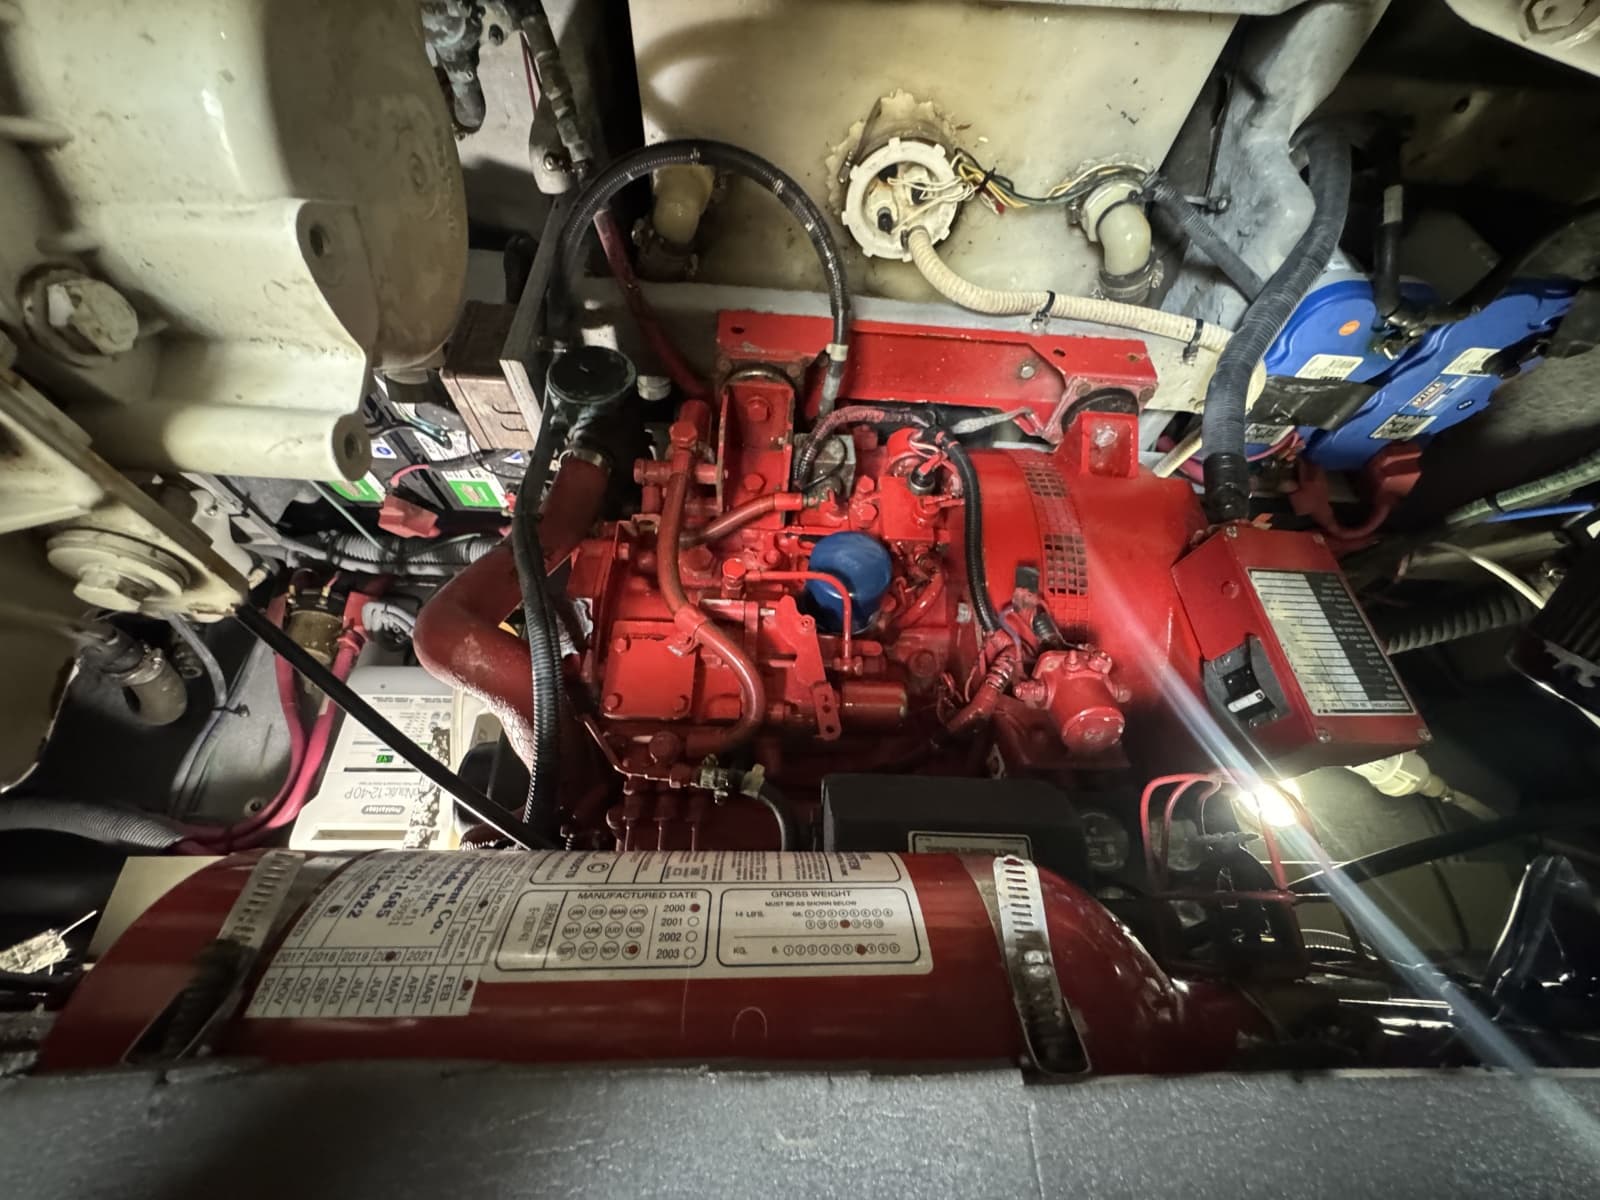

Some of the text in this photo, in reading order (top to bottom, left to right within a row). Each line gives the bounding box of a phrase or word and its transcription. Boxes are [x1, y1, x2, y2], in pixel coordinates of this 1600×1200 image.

[344, 787, 382, 801] 12-40P
[421, 893, 446, 918] Inc.
[577, 891, 698, 900] MANUFACTURED DATE
[771, 890, 852, 899] GROSS WEIGHT
[540, 904, 558, 931] SERIAL
[663, 904, 685, 913] 2000
[429, 909, 453, 935] Co.
[661, 918, 683, 927] 2001
[658, 932, 682, 943] 2002
[275, 951, 305, 962] 2017
[308, 951, 335, 962] 2018
[340, 951, 368, 962] 2019
[406, 951, 433, 961] 2021
[656, 949, 680, 960] 2003
[253, 977, 275, 1005] DEC
[275, 977, 293, 1005] NOV
[295, 977, 311, 1004] OCT
[314, 977, 329, 1003] SEP
[328, 976, 347, 1005] AUG
[347, 977, 364, 1000] JUL
[365, 976, 383, 1003] JUN
[384, 976, 402, 1004] MAY
[402, 976, 420, 1004] APR
[421, 974, 438, 1005] MAR
[439, 976, 455, 1001] FEB
